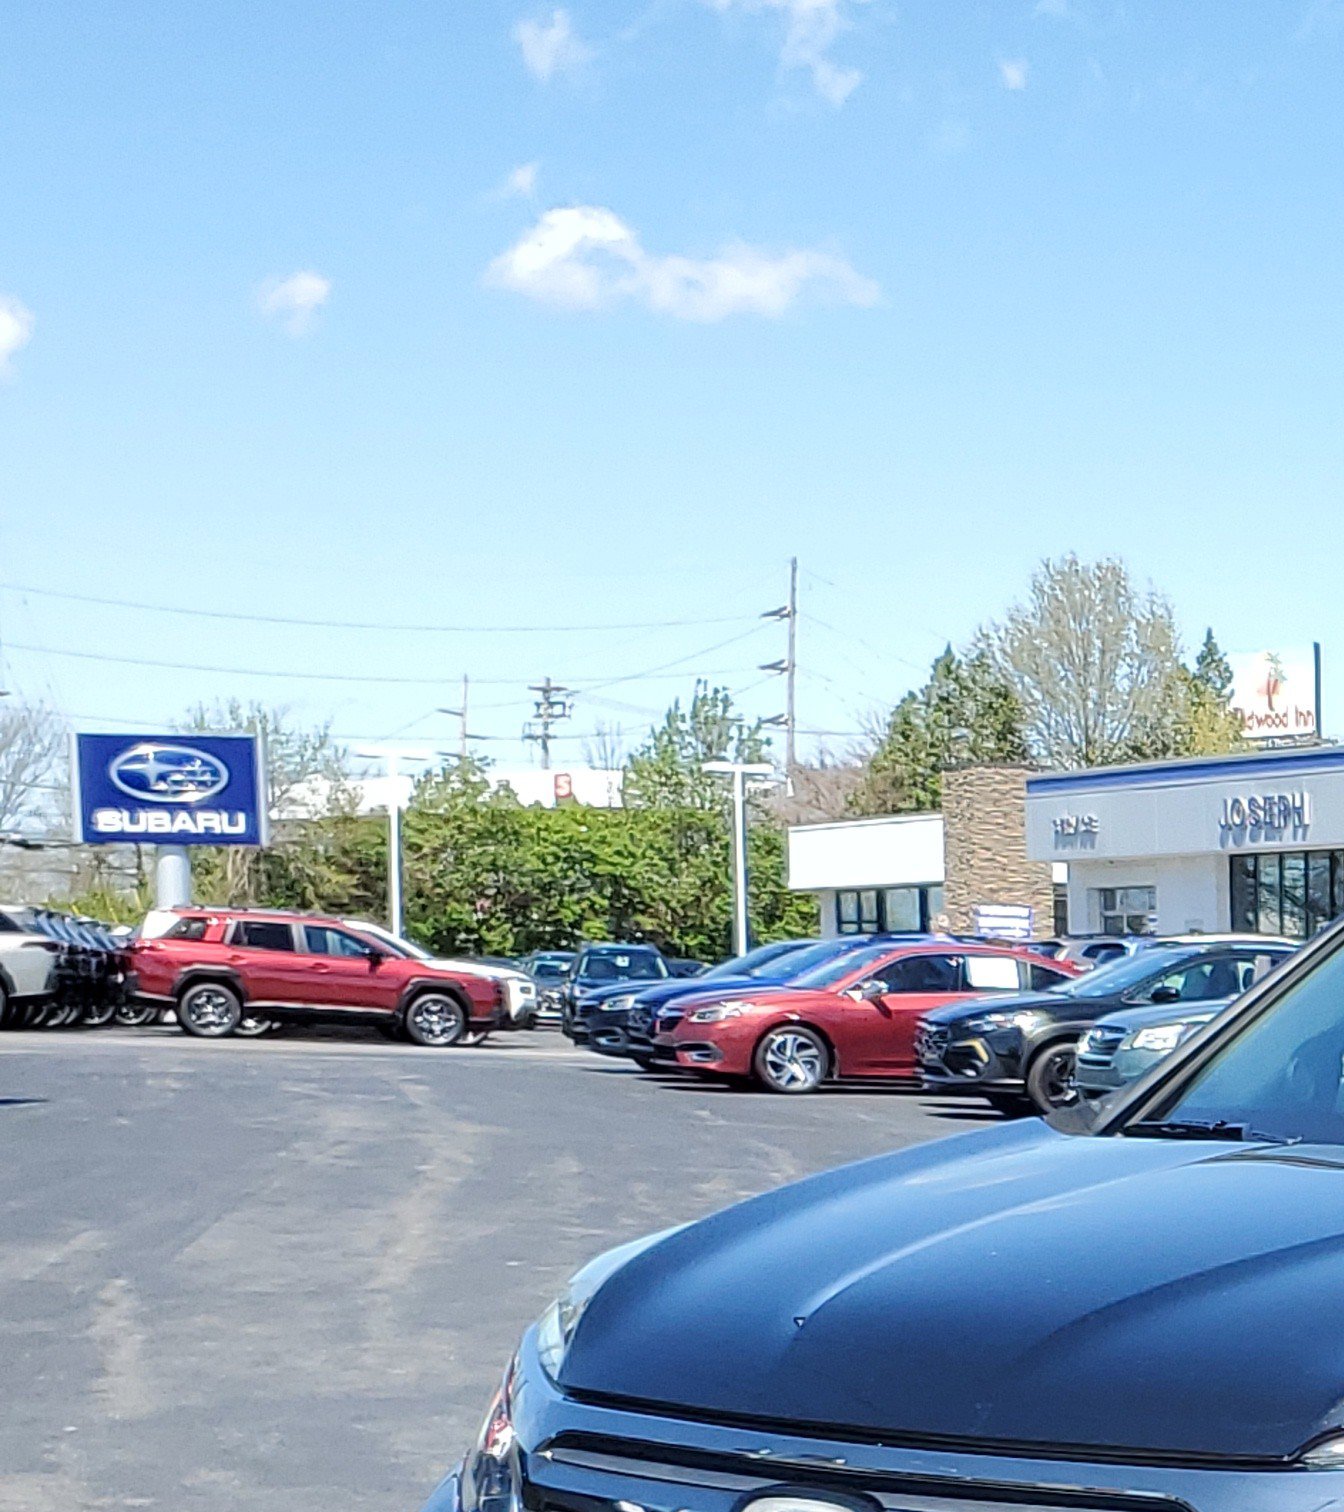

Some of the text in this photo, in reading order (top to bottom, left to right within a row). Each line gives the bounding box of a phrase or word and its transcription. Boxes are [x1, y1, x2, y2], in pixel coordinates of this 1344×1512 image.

[1294, 704, 1315, 728] Inn
[94, 809, 247, 834] SUBARU
[1219, 791, 1311, 831] JOSEPH
